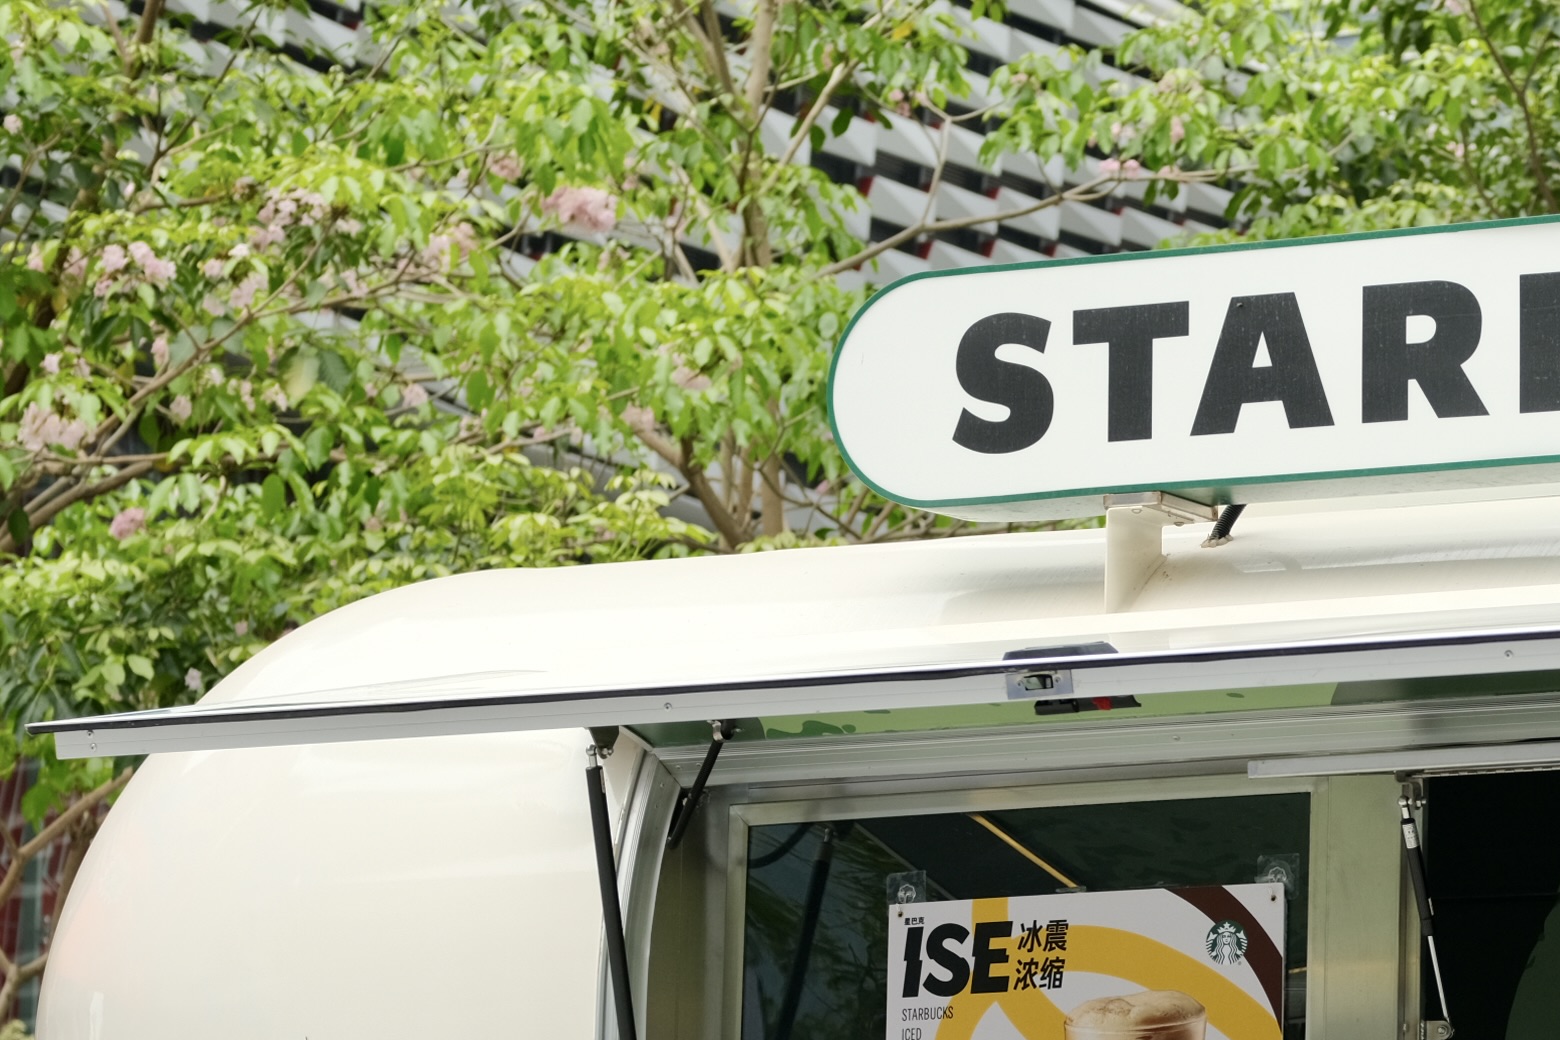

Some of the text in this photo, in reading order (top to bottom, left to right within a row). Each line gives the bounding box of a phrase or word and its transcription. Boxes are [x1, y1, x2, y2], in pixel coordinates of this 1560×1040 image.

[904, 917, 925, 925] 星巴克
[1017, 919, 1069, 953] 冰震
[902, 921, 1013, 998] ISE
[1013, 956, 1066, 991] 浓缩
[902, 1006, 954, 1021] STARBUCKS
[902, 1028, 922, 1040] ICED
